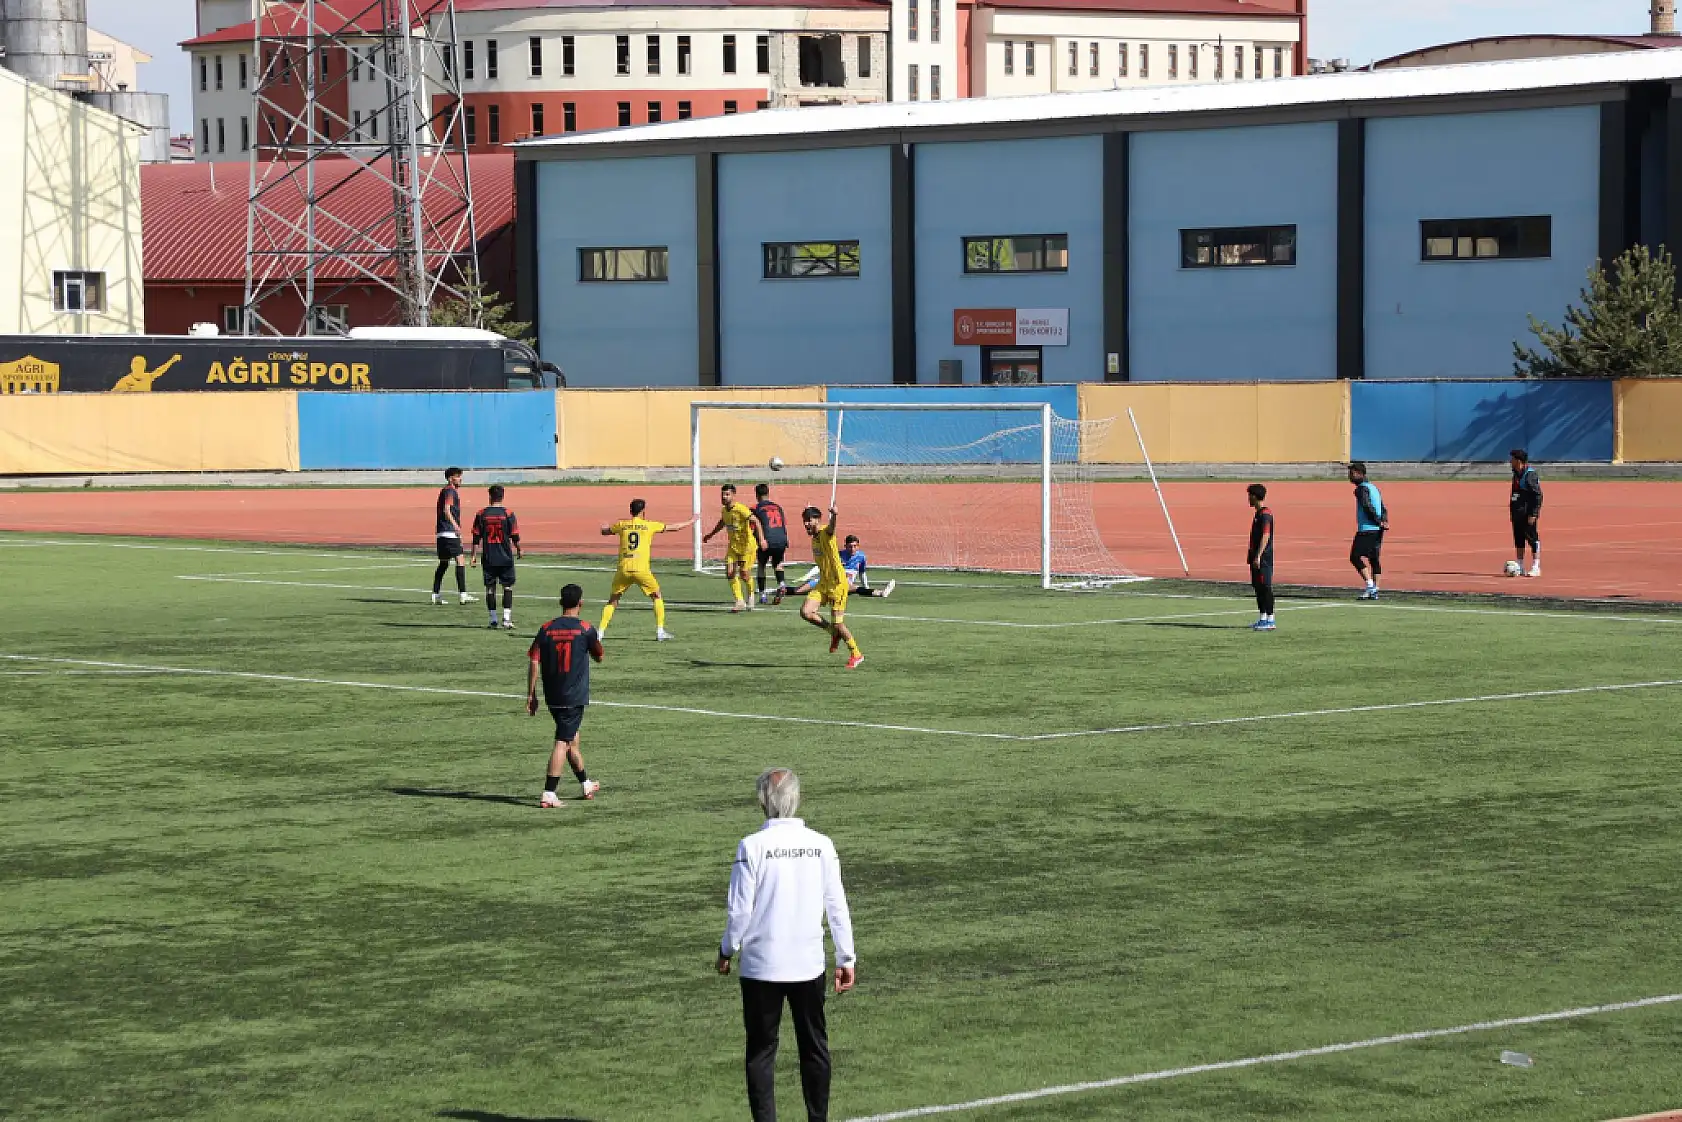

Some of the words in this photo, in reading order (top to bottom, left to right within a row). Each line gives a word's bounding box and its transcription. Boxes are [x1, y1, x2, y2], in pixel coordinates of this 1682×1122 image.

[205, 356, 280, 384] AĞRI
[290, 362, 372, 385] SPOR
[627, 531, 640, 551] 9
[556, 642, 572, 673] 11
